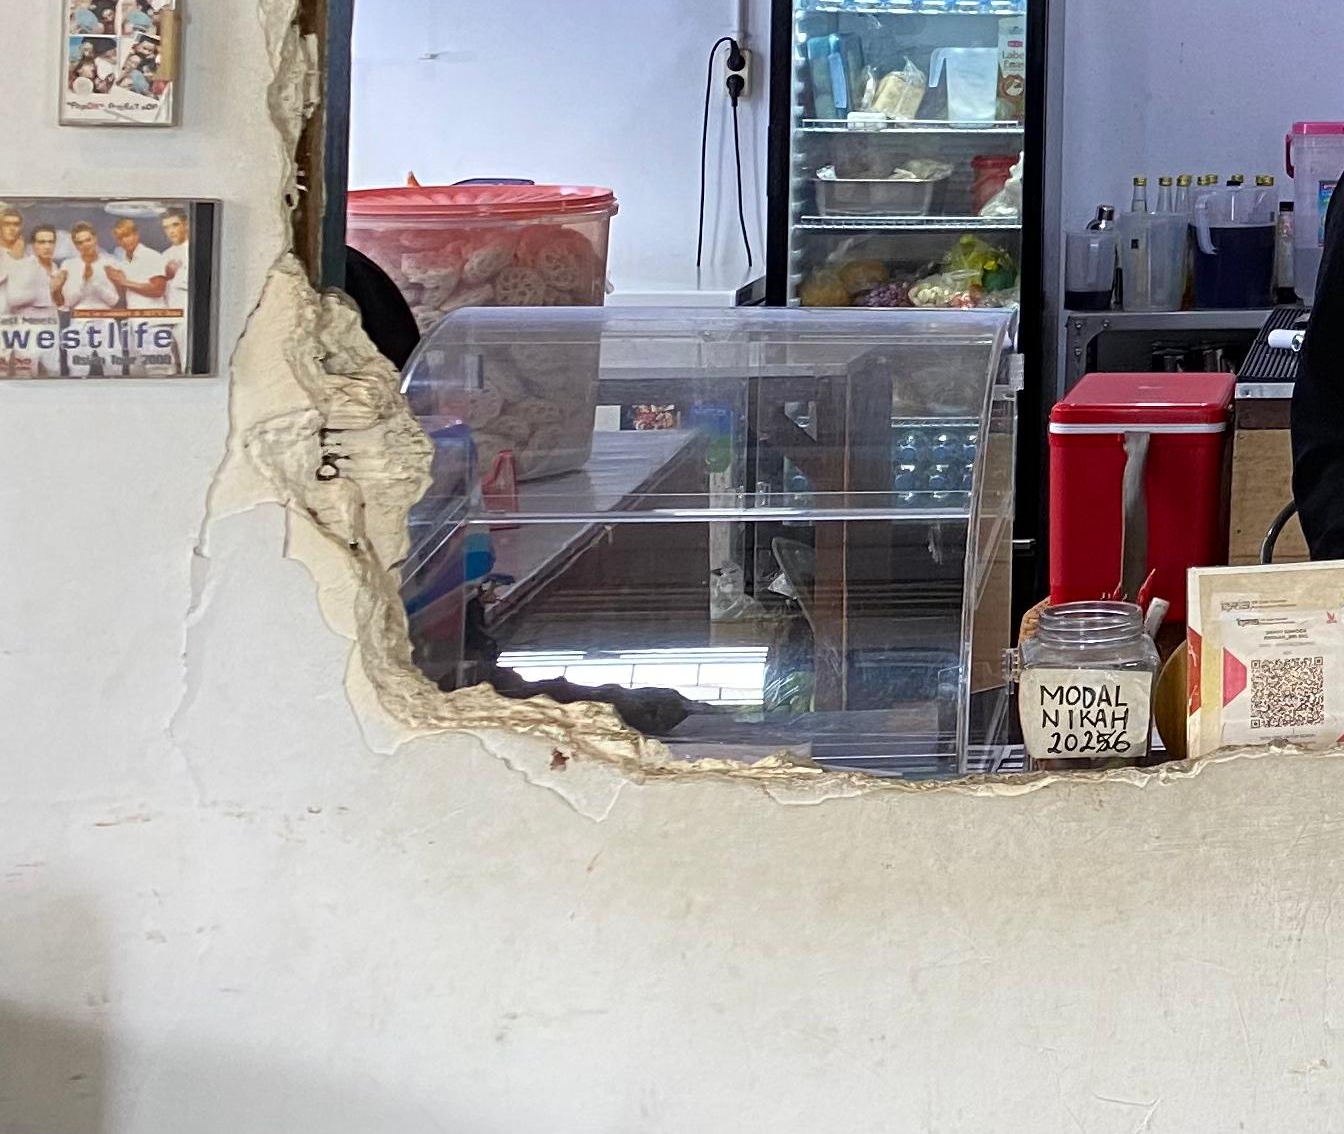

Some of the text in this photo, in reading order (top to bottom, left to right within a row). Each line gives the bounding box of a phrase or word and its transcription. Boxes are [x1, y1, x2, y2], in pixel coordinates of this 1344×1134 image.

[2, 321, 173, 350] westlife
[1040, 685, 1128, 708] MODAL
[1041, 707, 1129, 731] NIKAH
